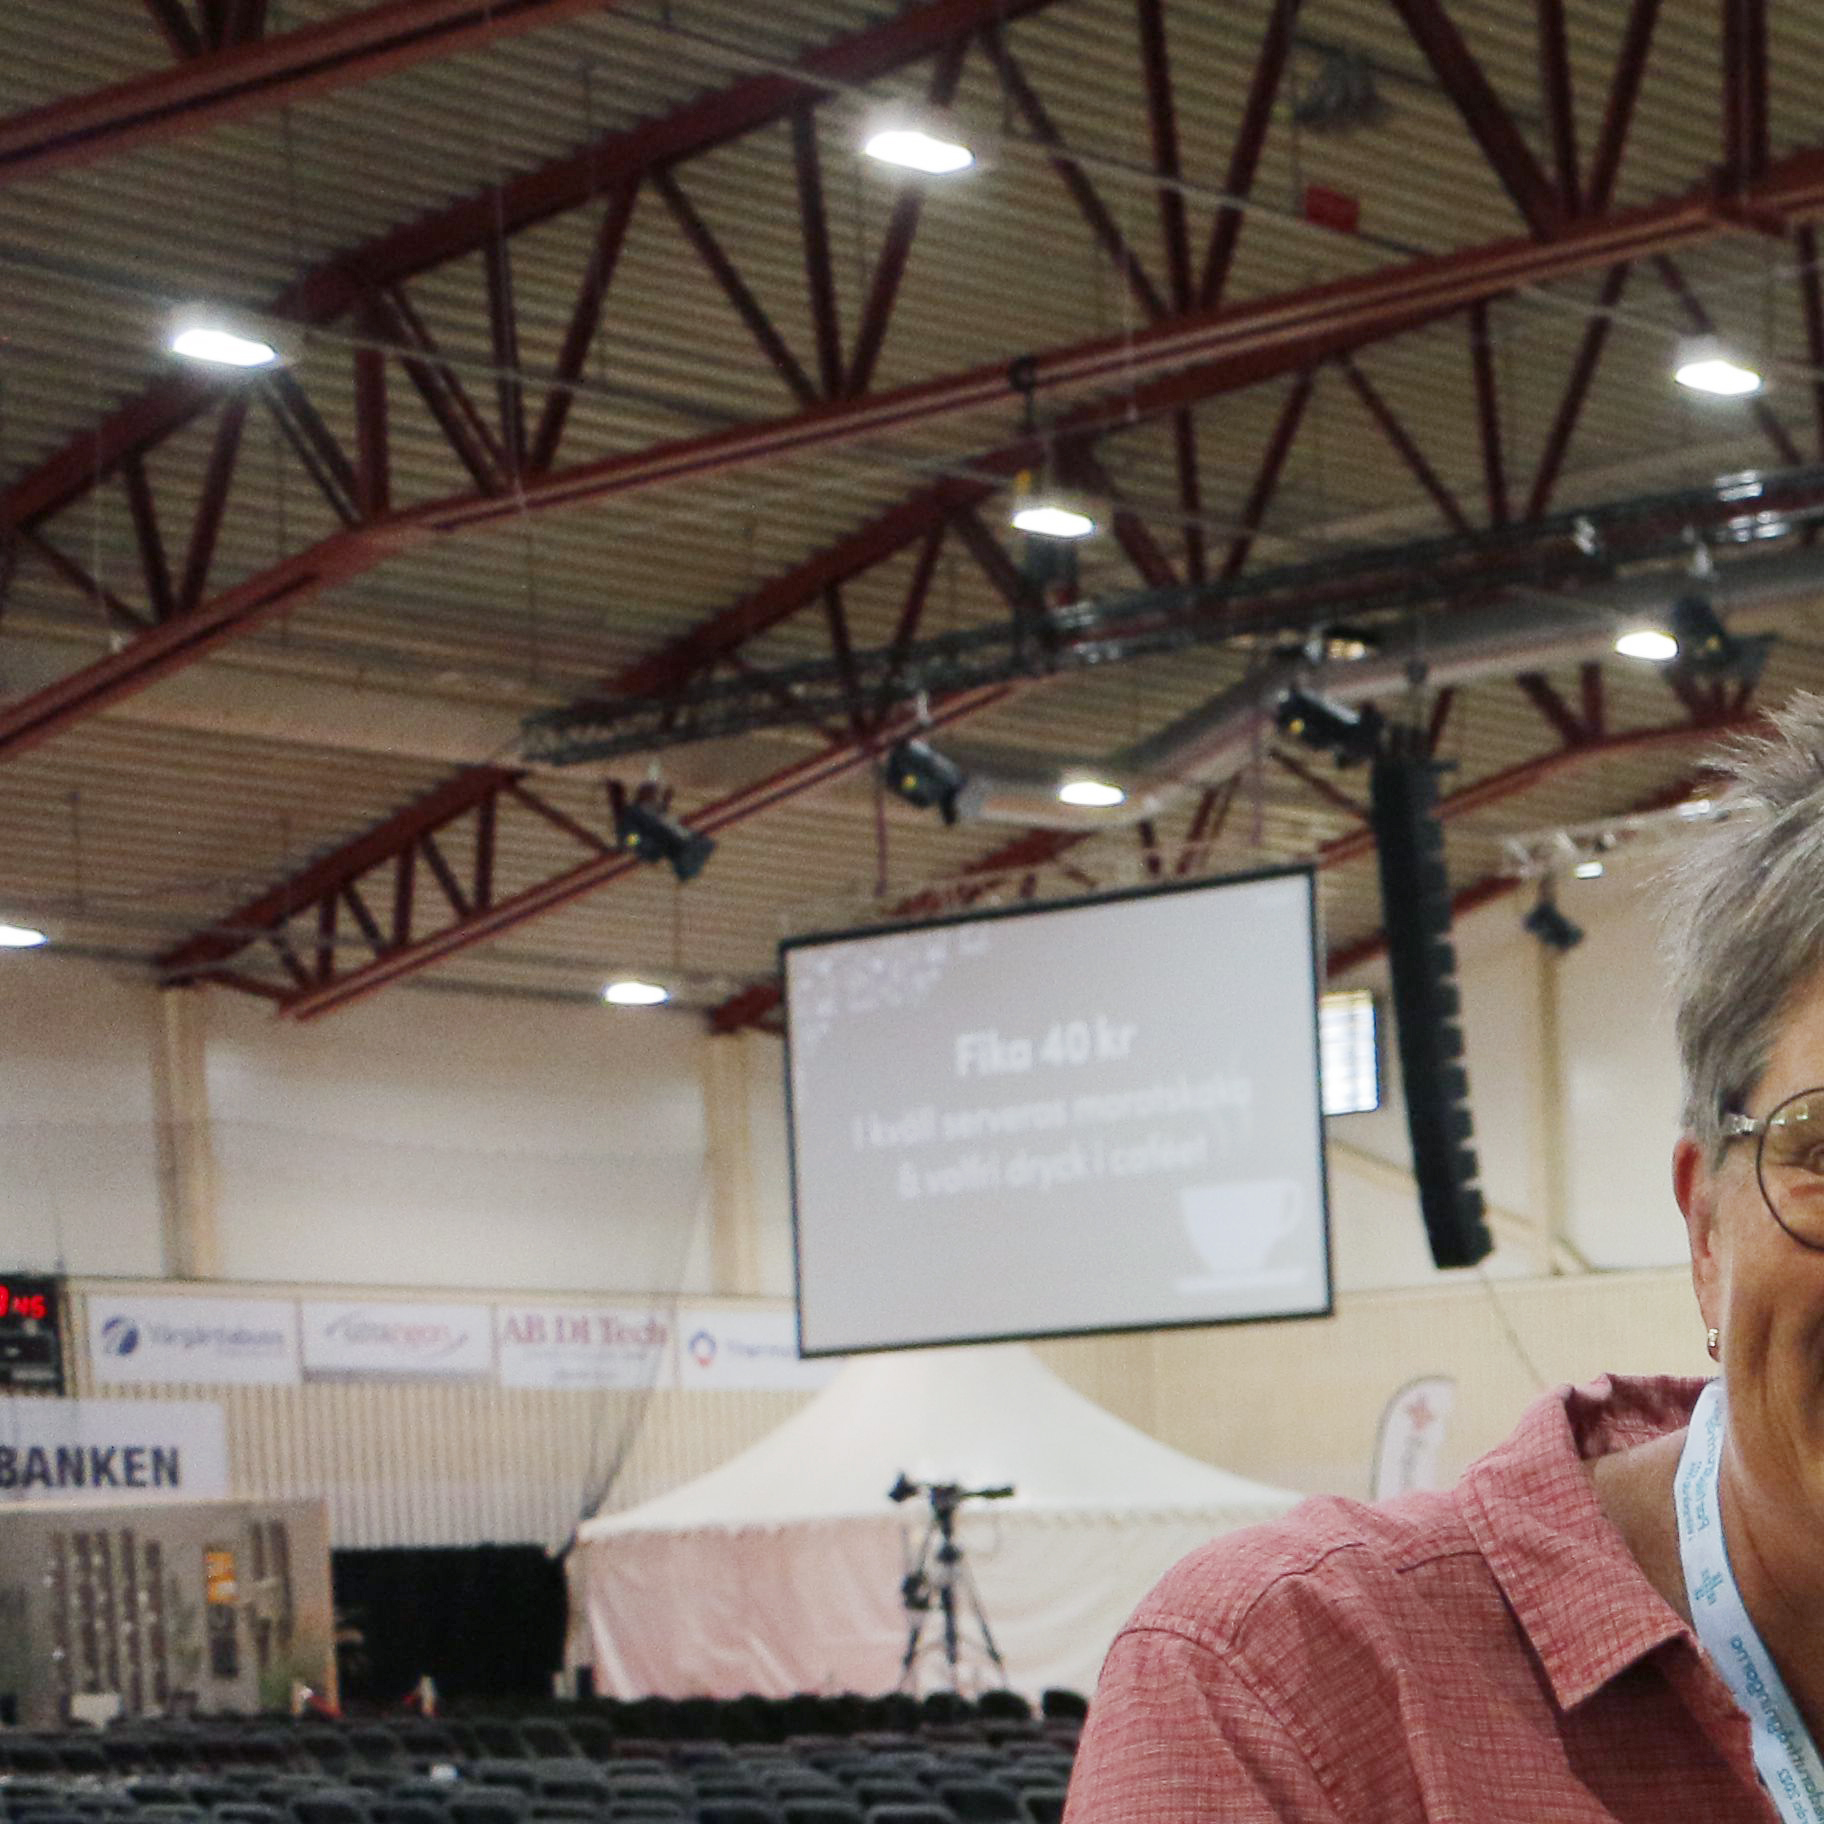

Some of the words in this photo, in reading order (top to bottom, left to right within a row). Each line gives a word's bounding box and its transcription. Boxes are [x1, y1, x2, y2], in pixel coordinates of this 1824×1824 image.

[954, 1027, 1029, 1077] Fika
[1039, 1020, 1090, 1067] 40
[1095, 1014, 1137, 1060] kr
[868, 1105, 938, 1147] kväll
[0, 1445, 181, 1489] BANKEN
